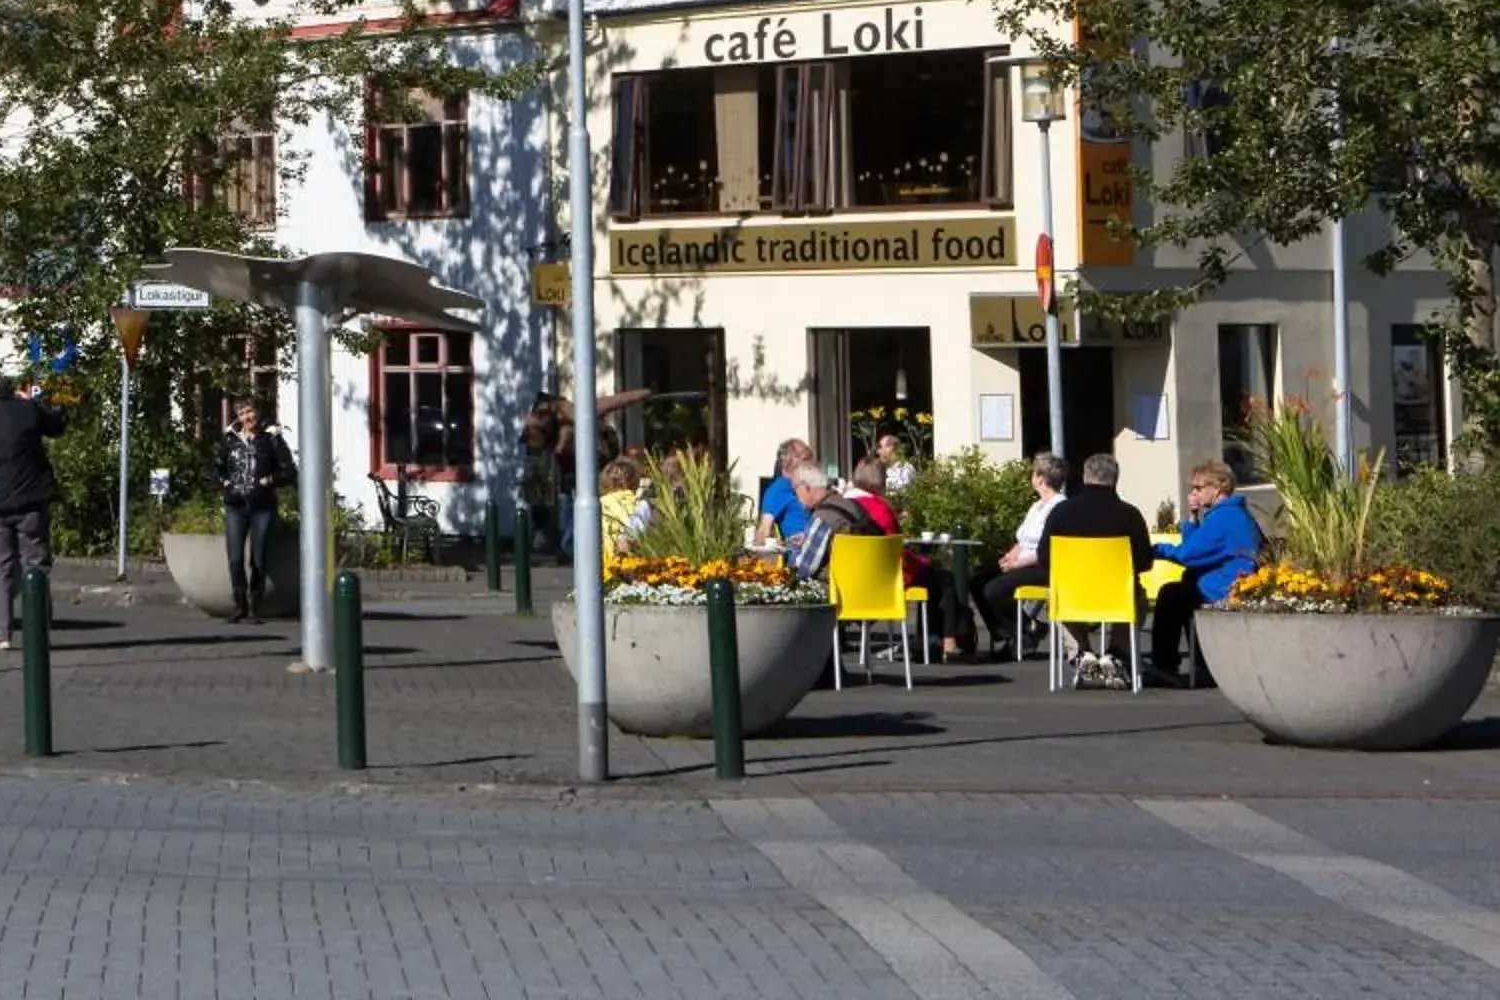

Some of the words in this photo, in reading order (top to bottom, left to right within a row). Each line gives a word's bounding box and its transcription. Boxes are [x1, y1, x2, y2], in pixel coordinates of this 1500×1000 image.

[704, 17, 796, 62] café
[822, 6, 924, 55] Loki
[1085, 172, 1131, 206] Loki
[618, 232, 746, 266] Icelandic
[756, 229, 920, 263] traditional
[932, 226, 1006, 261] food
[31, 385, 42, 398] P
